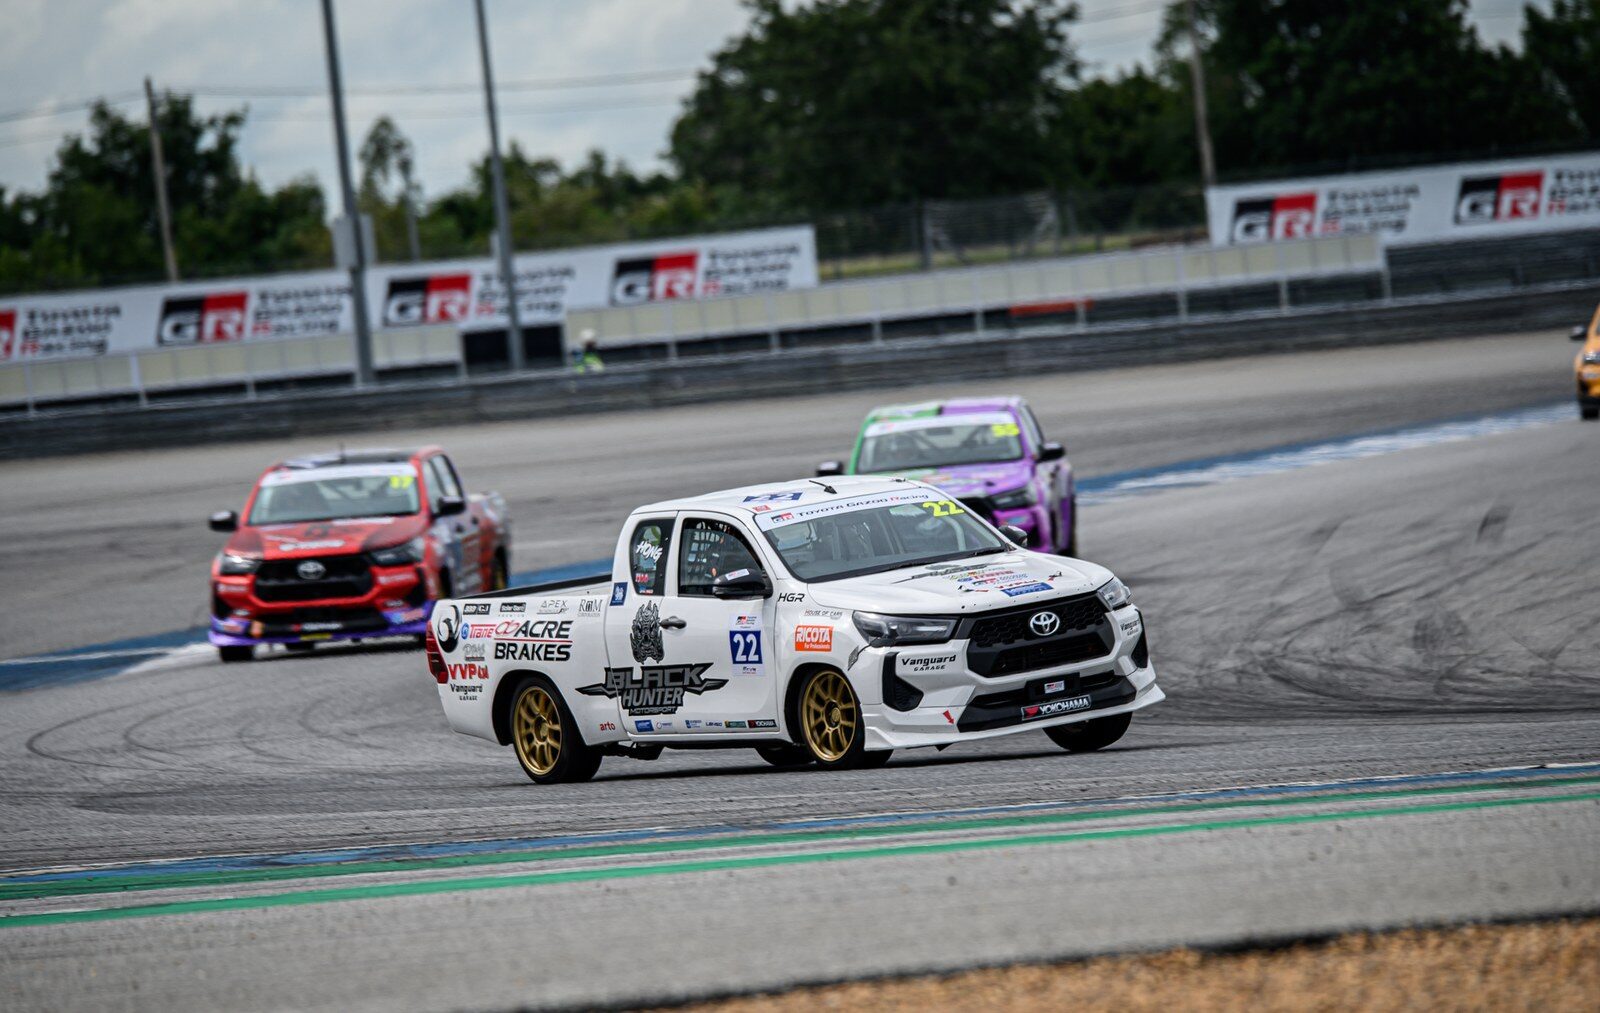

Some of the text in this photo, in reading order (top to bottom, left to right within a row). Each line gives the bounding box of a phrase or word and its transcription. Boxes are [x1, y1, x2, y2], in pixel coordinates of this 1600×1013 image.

[612, 266, 696, 304] GR
[385, 284, 470, 325] GR
[161, 306, 244, 345] GR
[798, 493, 930, 518] TOYOTA GAZOO Racing
[923, 500, 964, 517] 22
[636, 541, 663, 563] HONG
[778, 592, 805, 602] HGR
[514, 620, 574, 639] ACRE
[796, 627, 831, 642] RICOTA
[494, 643, 573, 661] BRAKES
[733, 633, 759, 661] 22
[902, 655, 957, 667] Vanguard
[606, 665, 708, 690] BLACK
[450, 683, 482, 694] Vanguard
[622, 687, 683, 706] HUNTER
[630, 706, 677, 715] MOTORSPORT
[1040, 698, 1089, 715] YOKOHAMA
[600, 721, 616, 731] arto
